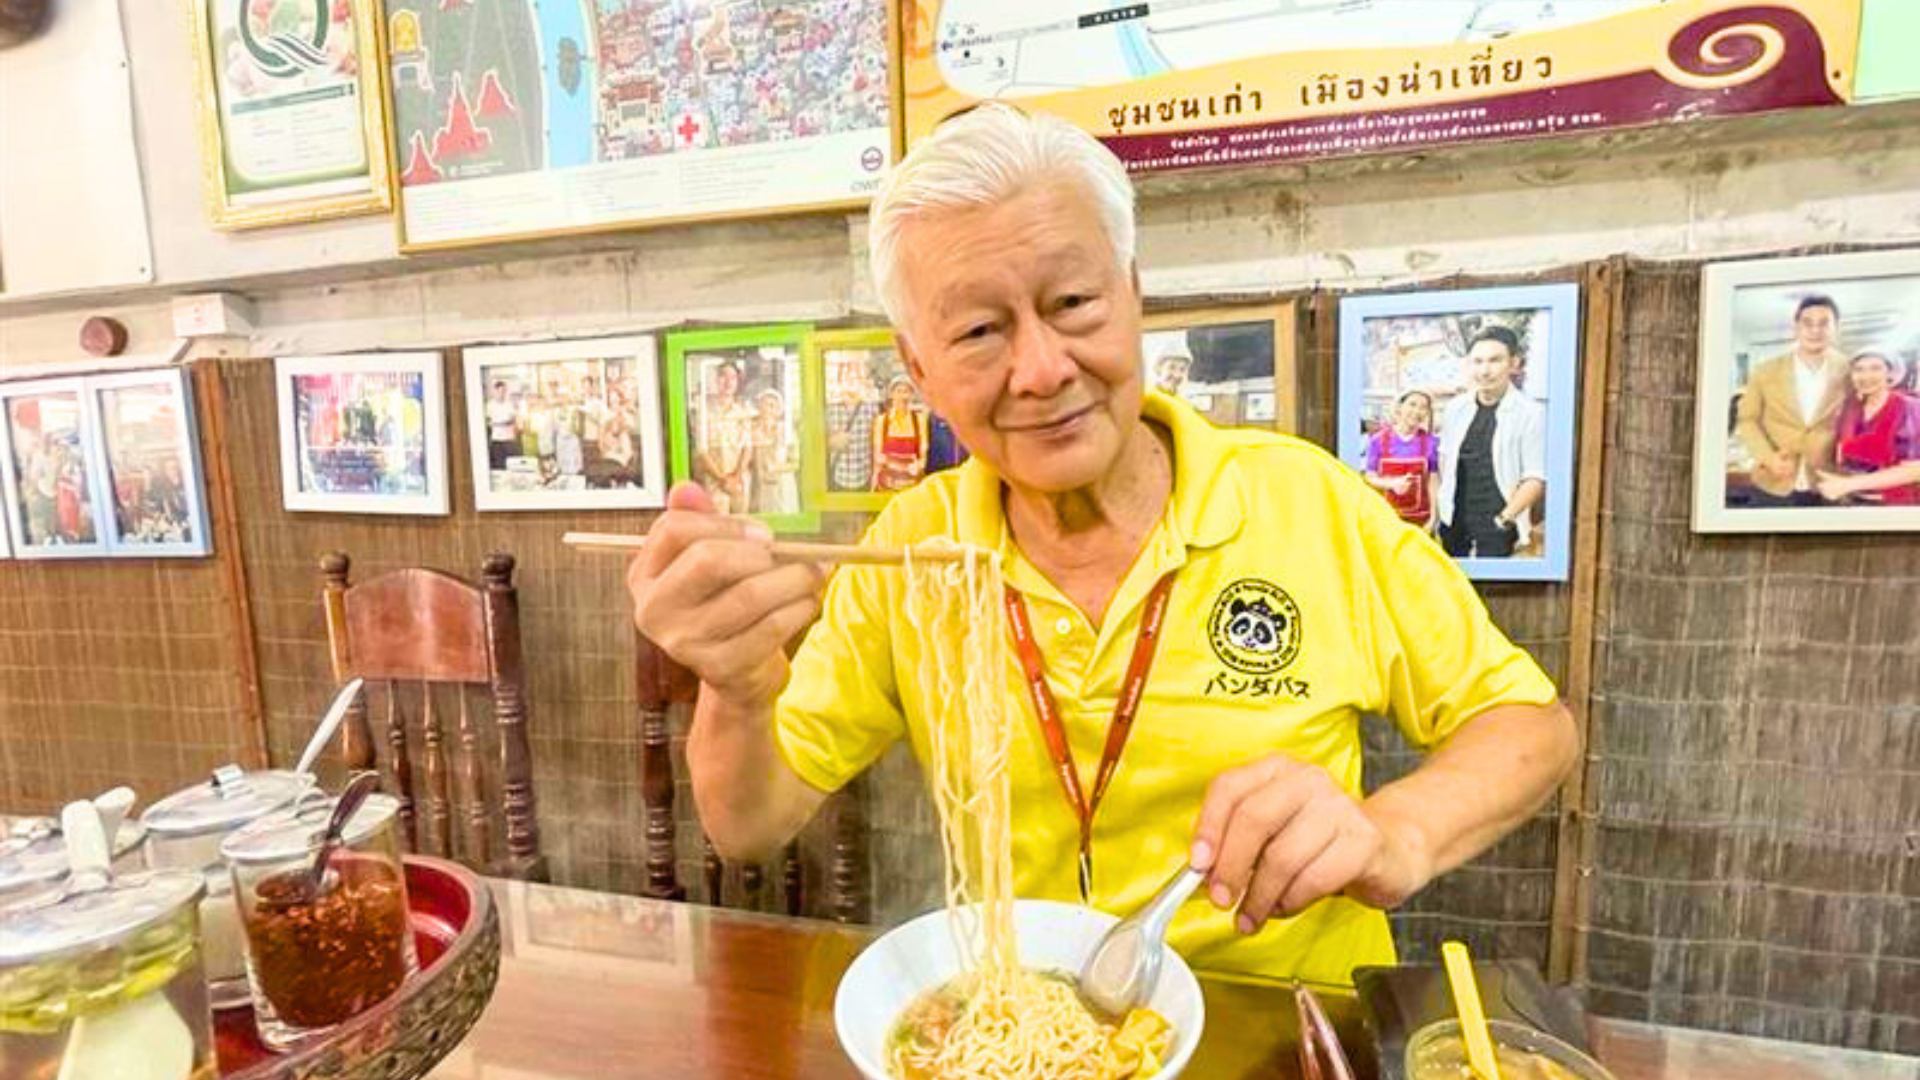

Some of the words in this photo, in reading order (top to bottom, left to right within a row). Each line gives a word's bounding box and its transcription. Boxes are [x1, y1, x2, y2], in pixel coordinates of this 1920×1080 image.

[1107, 82, 1262, 134] ชุมชนเก่า
[1204, 671, 1310, 699] パンダバス
